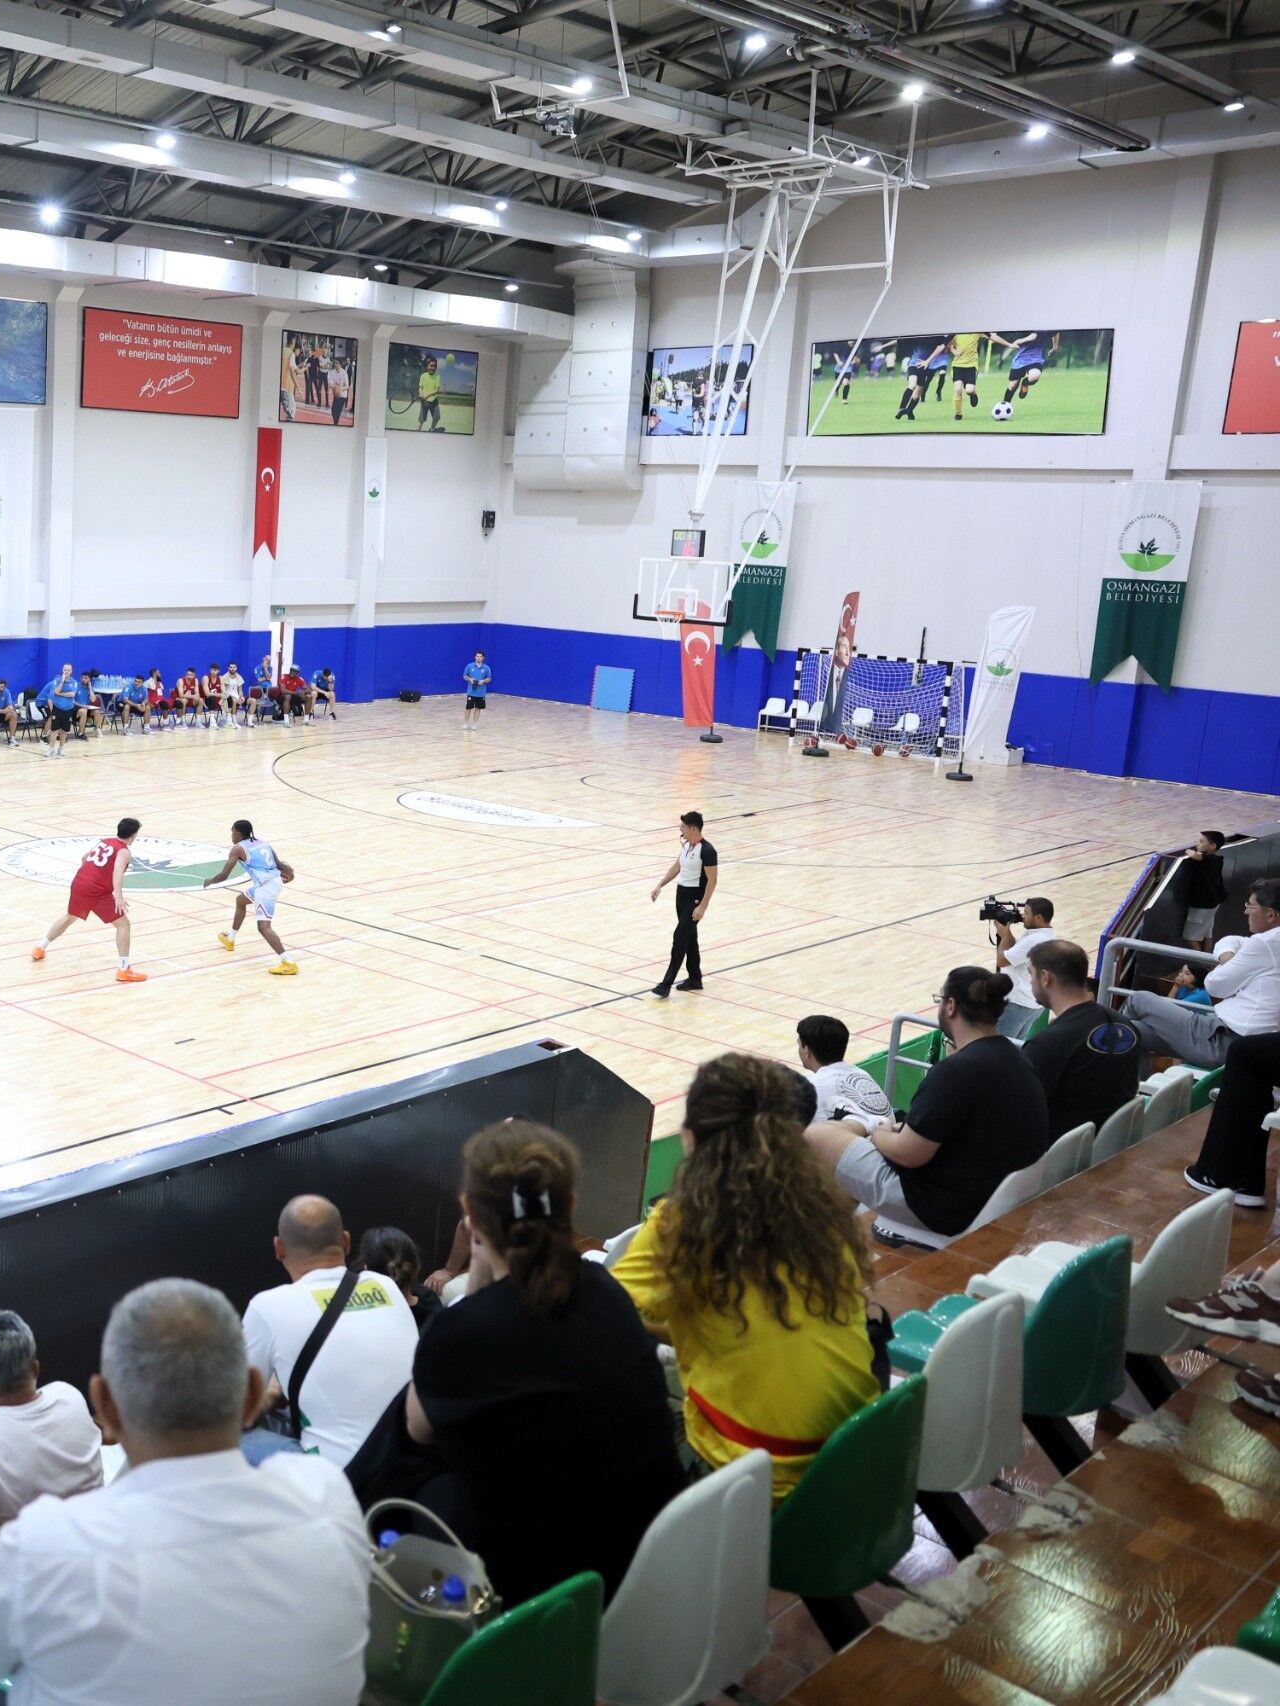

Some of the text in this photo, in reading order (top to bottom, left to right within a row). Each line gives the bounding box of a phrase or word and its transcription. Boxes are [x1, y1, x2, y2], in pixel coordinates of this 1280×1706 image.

[157, 324, 179, 335] bütün
[181, 326, 202, 336] ümidi
[203, 330, 212, 338] ve
[99, 331, 232, 354] geleceği size, genç nesillerin anlayış
[118, 349, 127, 357] ve
[128, 350, 165, 361] enerjisine
[86, 842, 114, 867] 53
